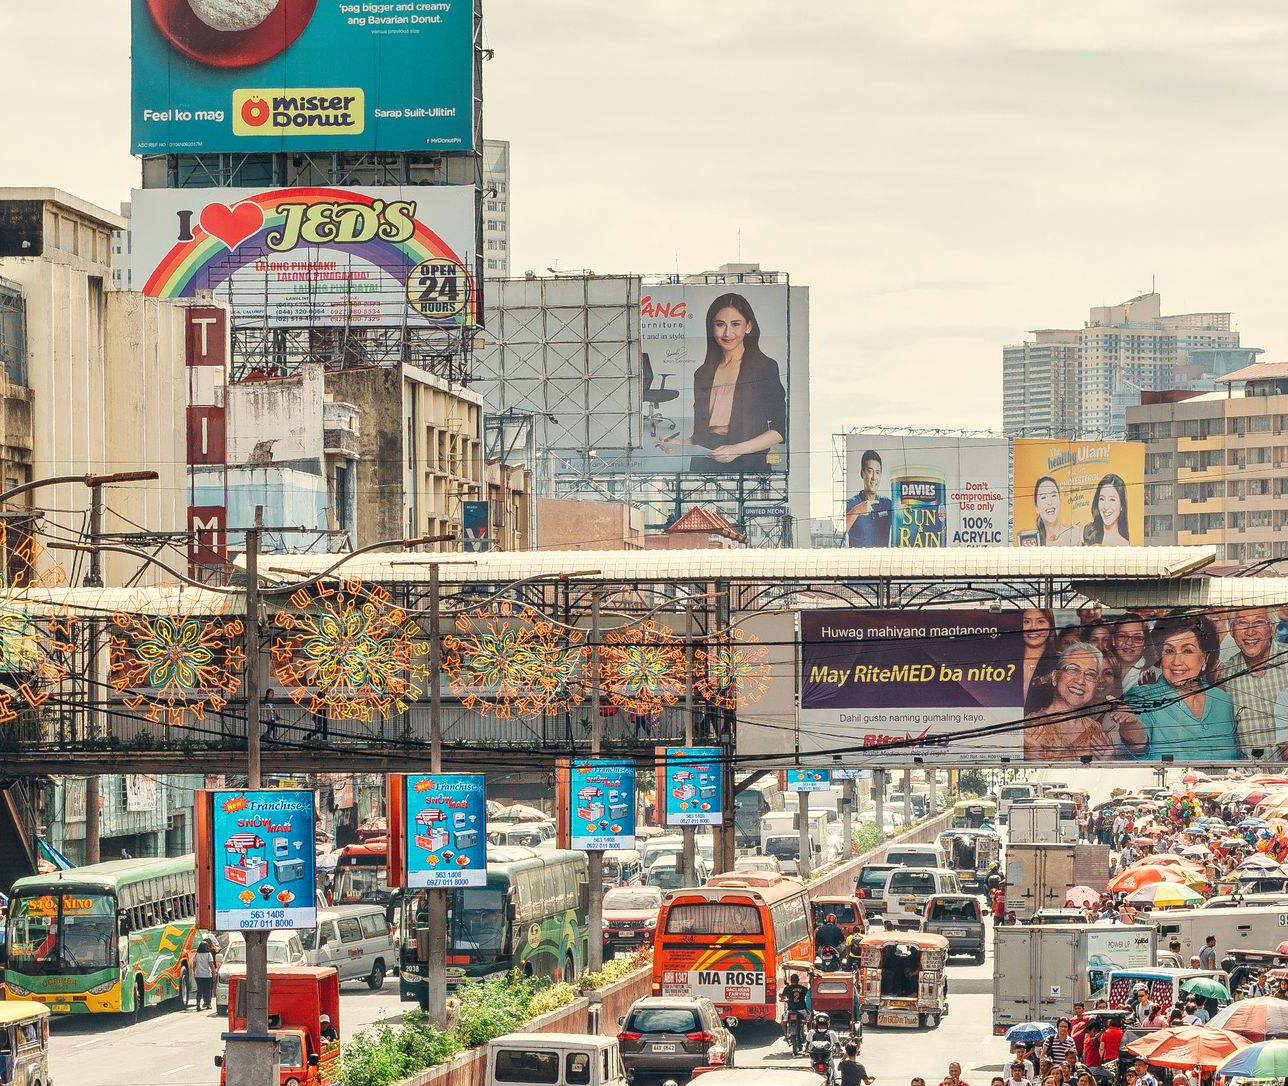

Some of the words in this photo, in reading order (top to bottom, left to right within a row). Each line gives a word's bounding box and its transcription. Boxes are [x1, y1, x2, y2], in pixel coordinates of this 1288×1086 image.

[362, 3, 393, 13] bigger
[396, 2, 414, 11] and
[416, 3, 451, 12] creamy
[347, 17, 366, 26] ang
[368, 15, 409, 25] Bavarian
[411, 15, 443, 24] Donut.
[272, 95, 355, 111] mister
[143, 110, 172, 122] Feel
[175, 109, 192, 121] ko
[195, 110, 224, 122] mag
[374, 109, 402, 119] Sarap
[404, 107, 456, 118] Sulit-Ulitin!
[273, 111, 355, 128] Donut
[177, 210, 194, 241] I
[266, 199, 417, 252] JED'S
[420, 264, 456, 276] OPEN
[418, 276, 459, 301] 24
[420, 302, 456, 313] HOURS
[902, 484, 936, 496] DAVIES
[965, 481, 989, 492] Don't
[951, 491, 1003, 503] compromise.
[959, 502, 975, 512] Use
[976, 501, 995, 513] only
[902, 507, 937, 527] SUN
[962, 517, 993, 529] 100%
[899, 527, 942, 547] RAIN
[952, 530, 1002, 543] ACRYLIC
[821, 626, 863, 639] Huwag
[867, 625, 926, 639] mahiyang
[929, 625, 1001, 639] magtanong.
[809, 665, 850, 688] May
[854, 664, 936, 683] RiteMED
[939, 663, 962, 682] ba
[967, 663, 1016, 682] nito?
[839, 714, 861, 723] Dahil
[863, 714, 887, 725] gusto
[889, 713, 920, 724] naming
[922, 713, 961, 724] gumaling
[963, 713, 986, 723] kayo.
[227, 799, 245, 811] New!
[250, 800, 301, 812] Franchise
[238, 815, 271, 829] SNOW
[267, 821, 292, 833] MAN
[251, 910, 265, 919] 563
[266, 910, 285, 919] 1408
[240, 919, 259, 929] 0927
[261, 919, 273, 928] 011
[274, 919, 293, 928] 8000
[699, 972, 721, 985] MA
[725, 971, 764, 986] ROSE
